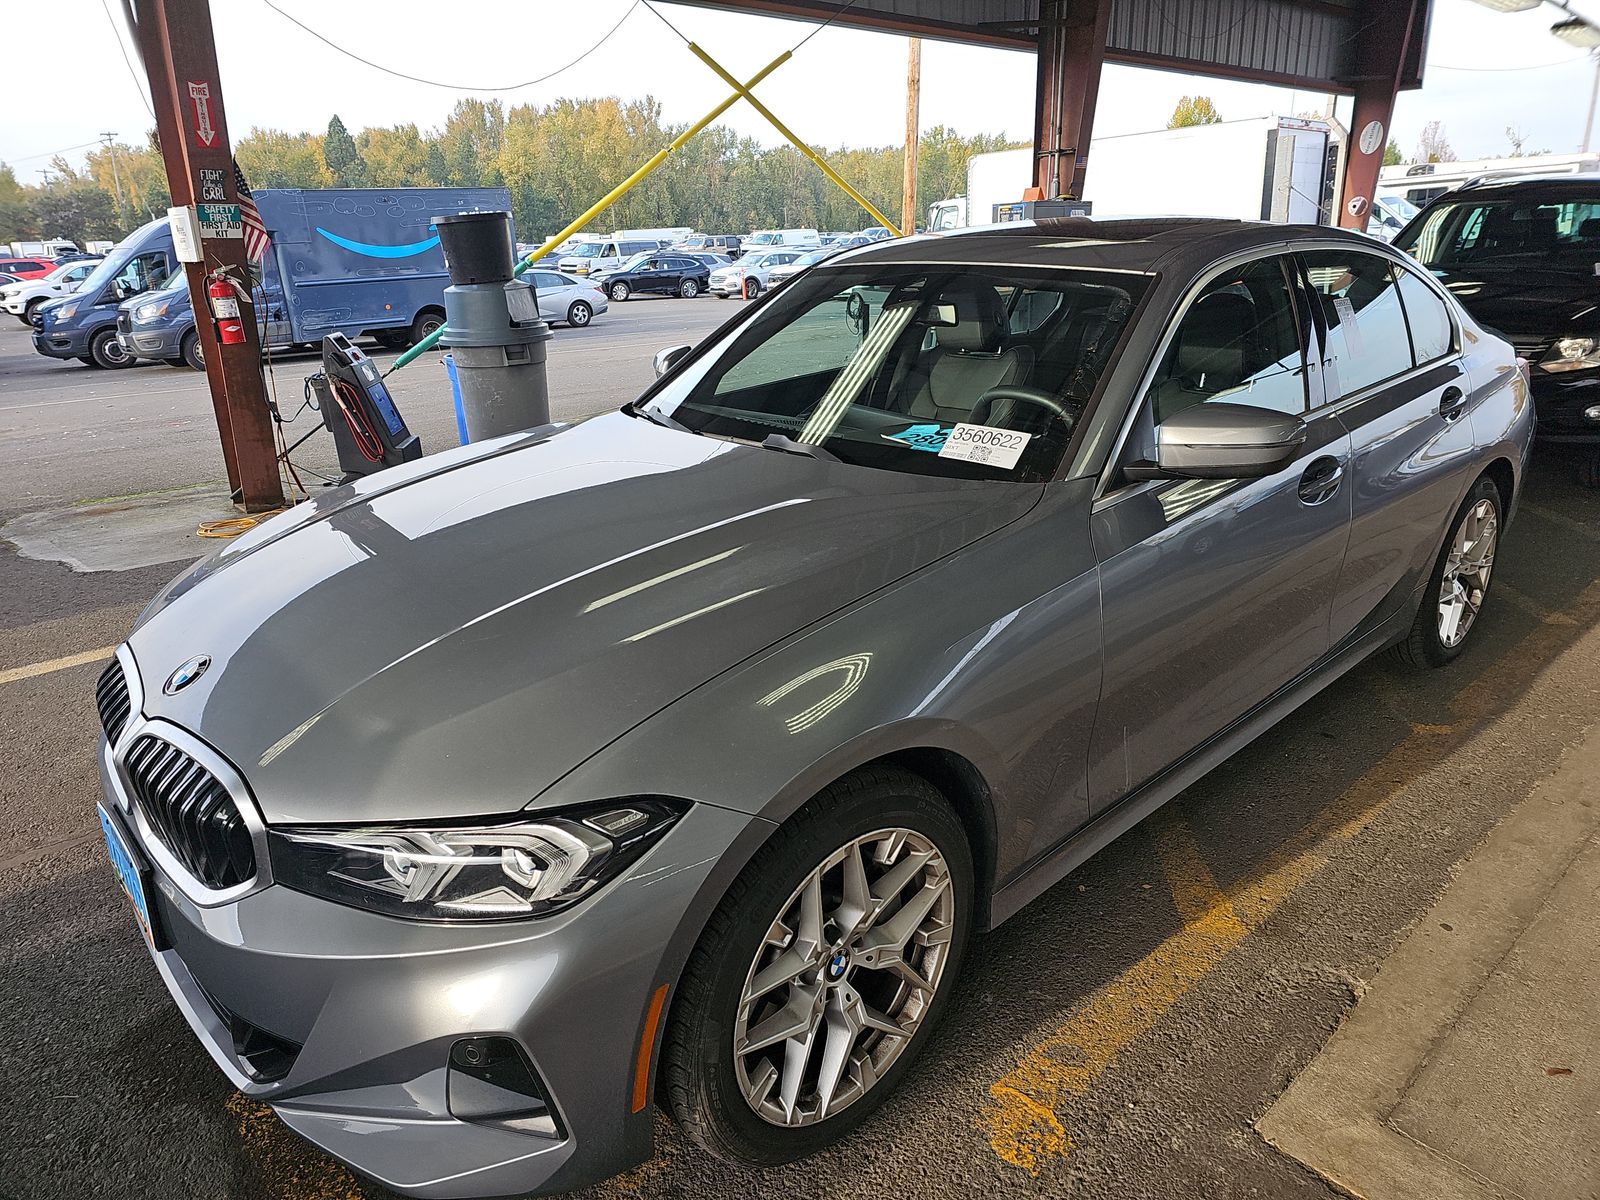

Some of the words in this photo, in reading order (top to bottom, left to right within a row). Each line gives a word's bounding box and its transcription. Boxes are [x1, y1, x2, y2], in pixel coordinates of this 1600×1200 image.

[191, 87, 207, 96] FIRE
[204, 205, 235, 214] SAFETY
[209, 213, 232, 222] FIRST
[201, 221, 223, 230] FIRST
[226, 221, 241, 230] AID
[215, 230, 229, 238] KIT
[953, 427, 1023, 450] 3560622
